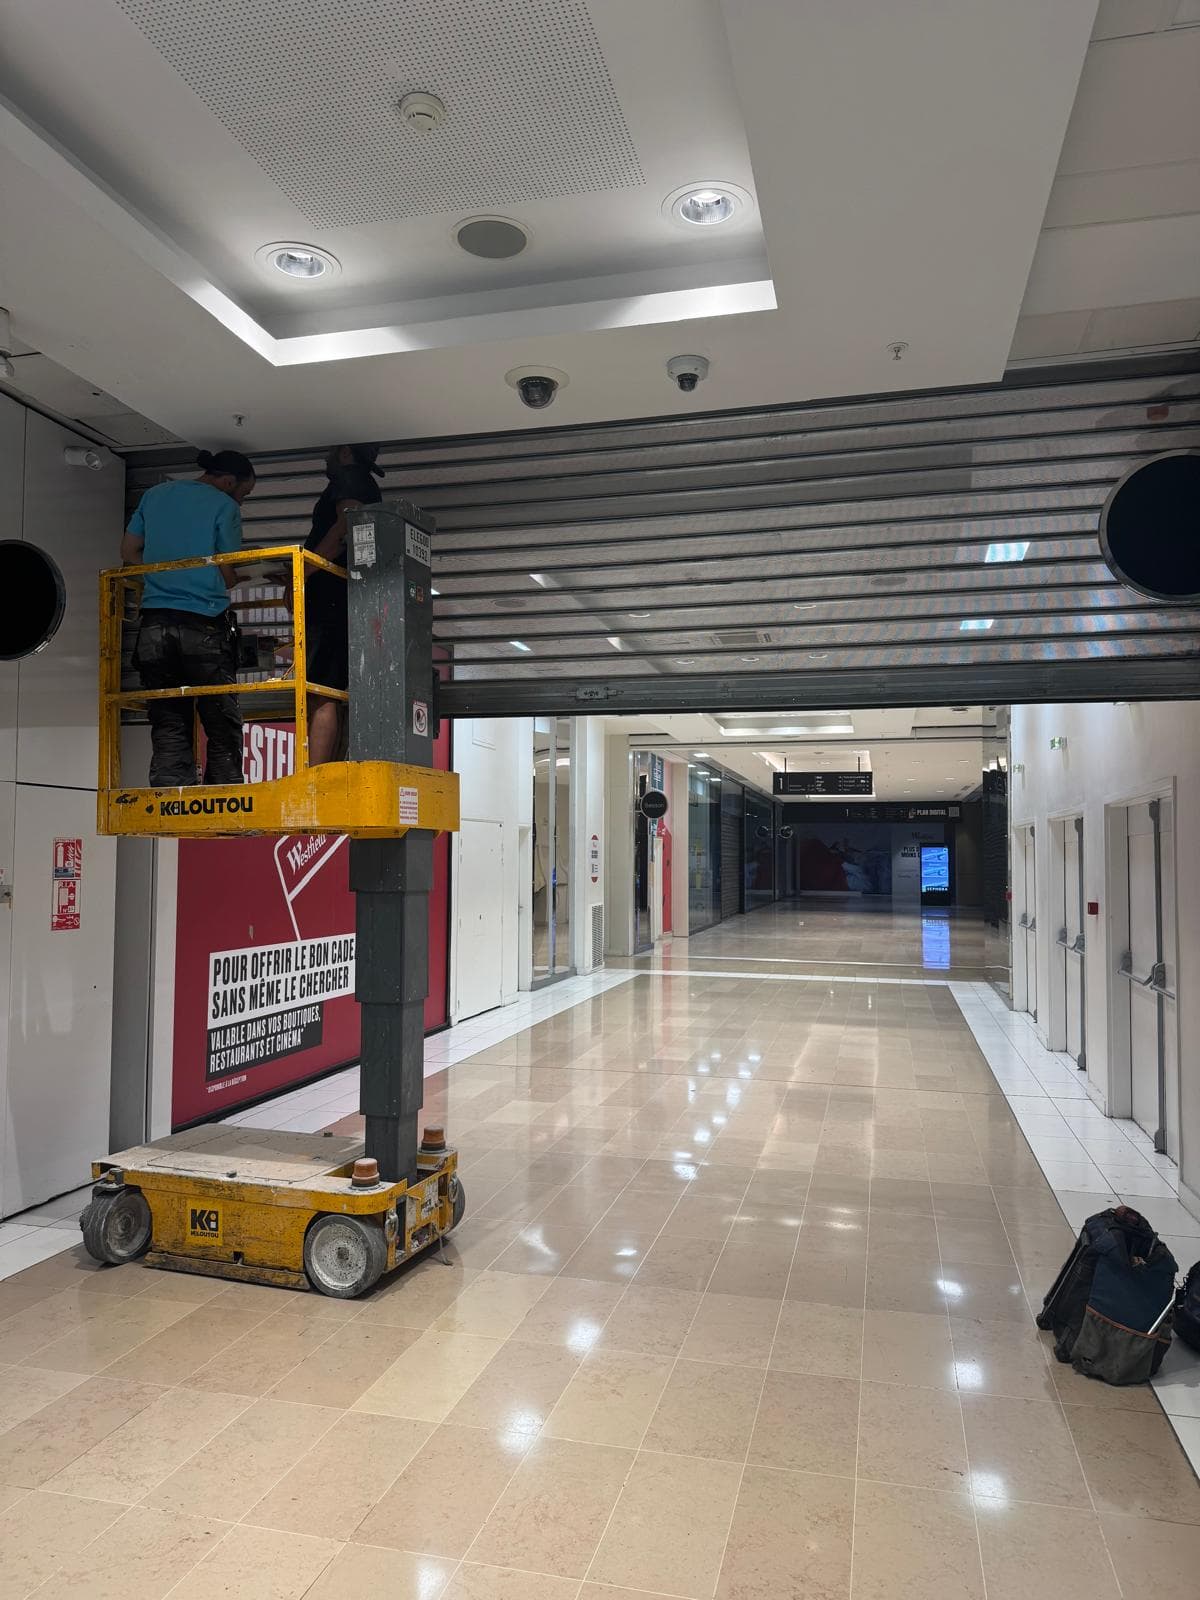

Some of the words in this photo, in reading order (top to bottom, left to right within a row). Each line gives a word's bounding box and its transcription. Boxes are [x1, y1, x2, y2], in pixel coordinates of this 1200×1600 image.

[242, 722, 295, 784] ESTFI
[213, 953, 248, 986] POUR
[251, 947, 292, 979] OFFRIR
[294, 945, 307, 971] LE
[309, 942, 329, 968] BON
[332, 938, 355, 964] CADE
[212, 986, 246, 1020] SANS
[249, 978, 281, 1011] MÊME
[284, 976, 297, 1002] LE
[299, 966, 349, 999] CHERCHER
[209, 1042, 264, 1073] RESTAURANTS
[266, 1036, 275, 1054] ET
[210, 1025, 245, 1052] VALABLE
[246, 1019, 266, 1042] DANS
[268, 1016, 282, 1035] VOS
